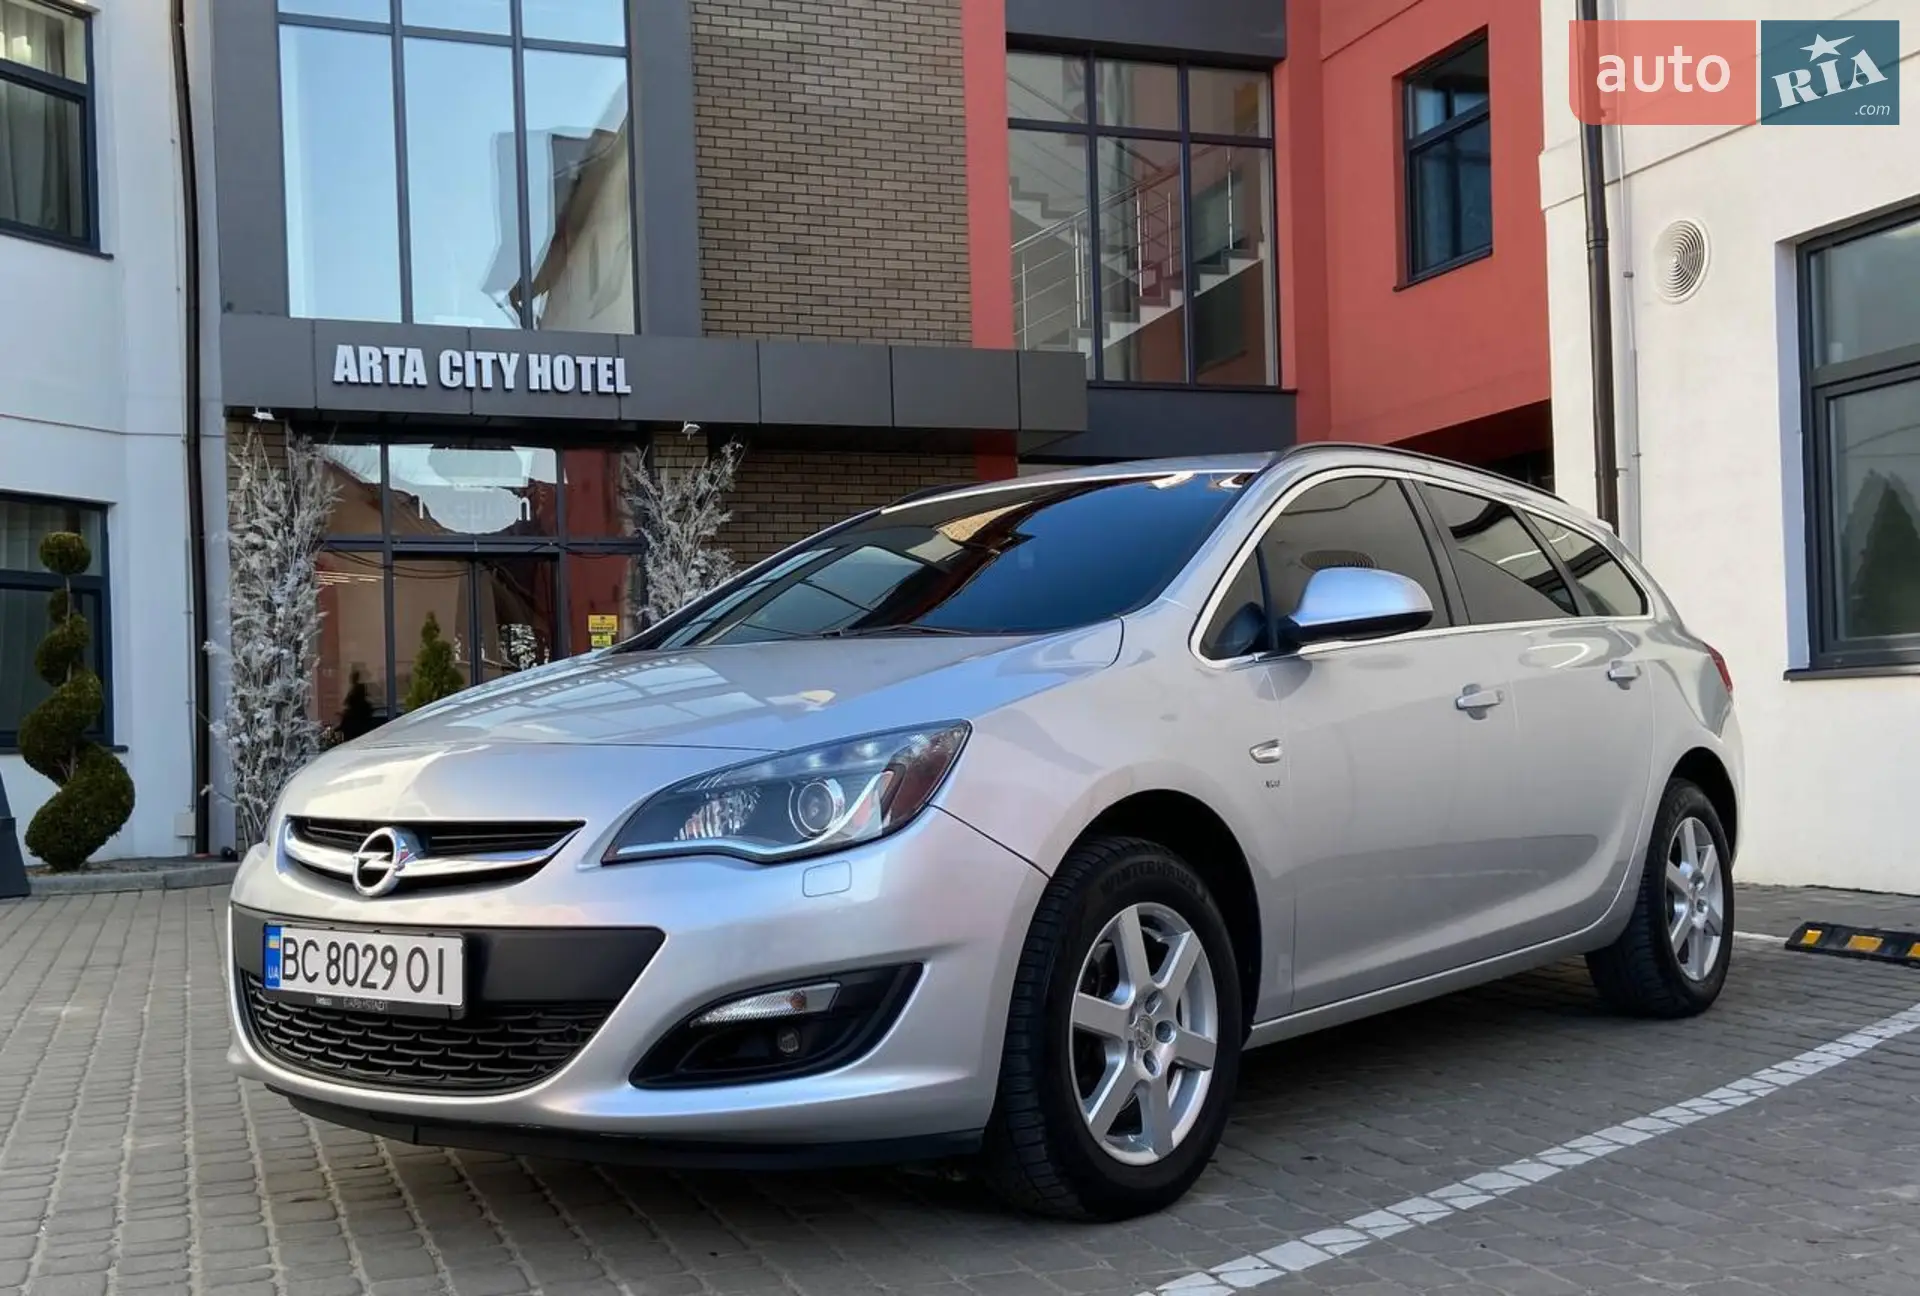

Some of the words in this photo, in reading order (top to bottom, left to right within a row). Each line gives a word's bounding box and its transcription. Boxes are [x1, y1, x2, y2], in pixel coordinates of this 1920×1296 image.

[333, 345, 428, 387] ARTA
[439, 349, 520, 389] CITY
[528, 353, 632, 395] HOTEL
[268, 966, 280, 980] UA
[282, 937, 320, 983] BC
[326, 941, 398, 990] 8029
[406, 946, 444, 995] OI
